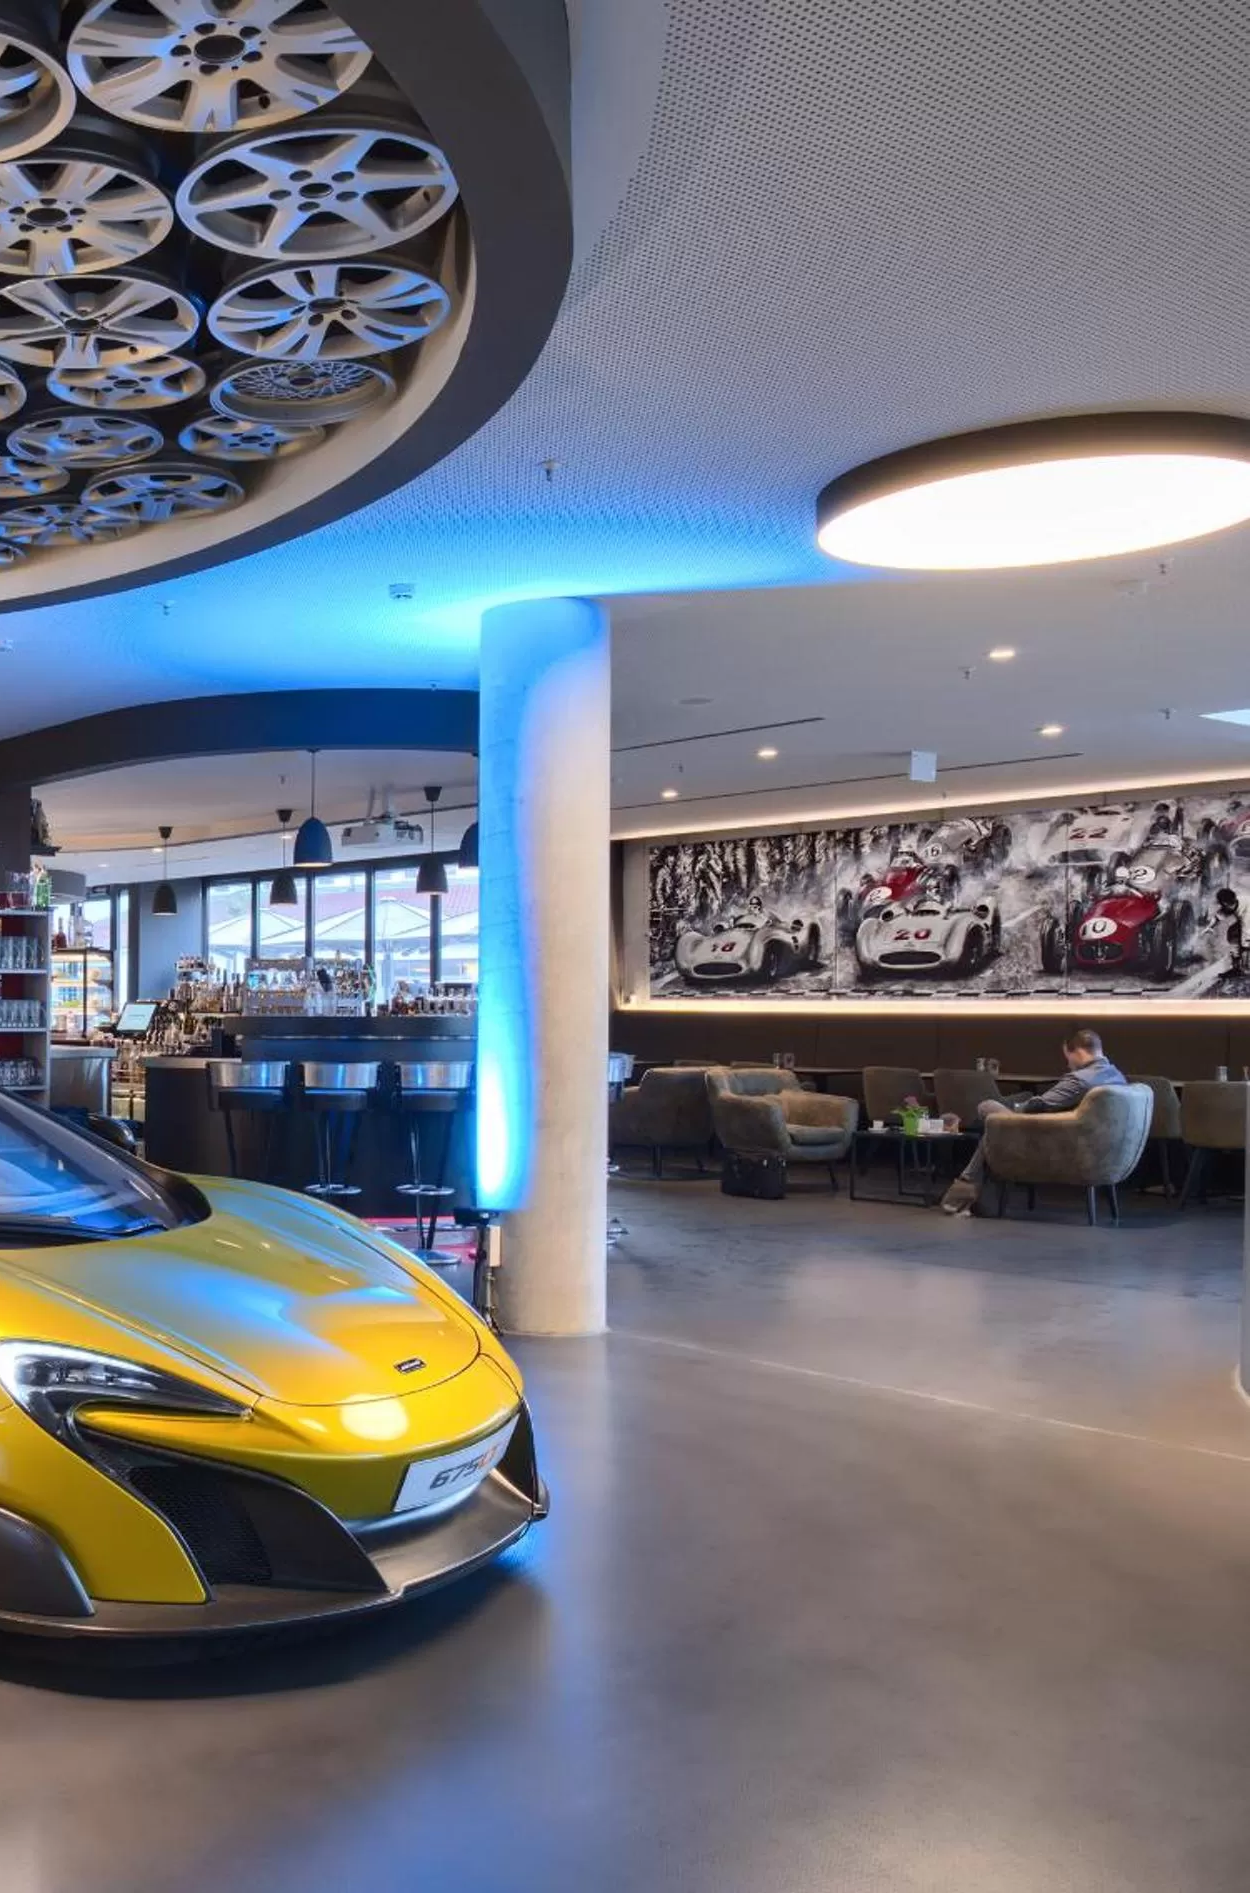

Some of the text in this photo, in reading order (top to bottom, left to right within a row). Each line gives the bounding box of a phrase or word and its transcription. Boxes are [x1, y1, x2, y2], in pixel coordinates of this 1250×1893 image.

[1069, 827, 1108, 839] 22
[1081, 919, 1107, 936] 10
[893, 928, 931, 941] 20
